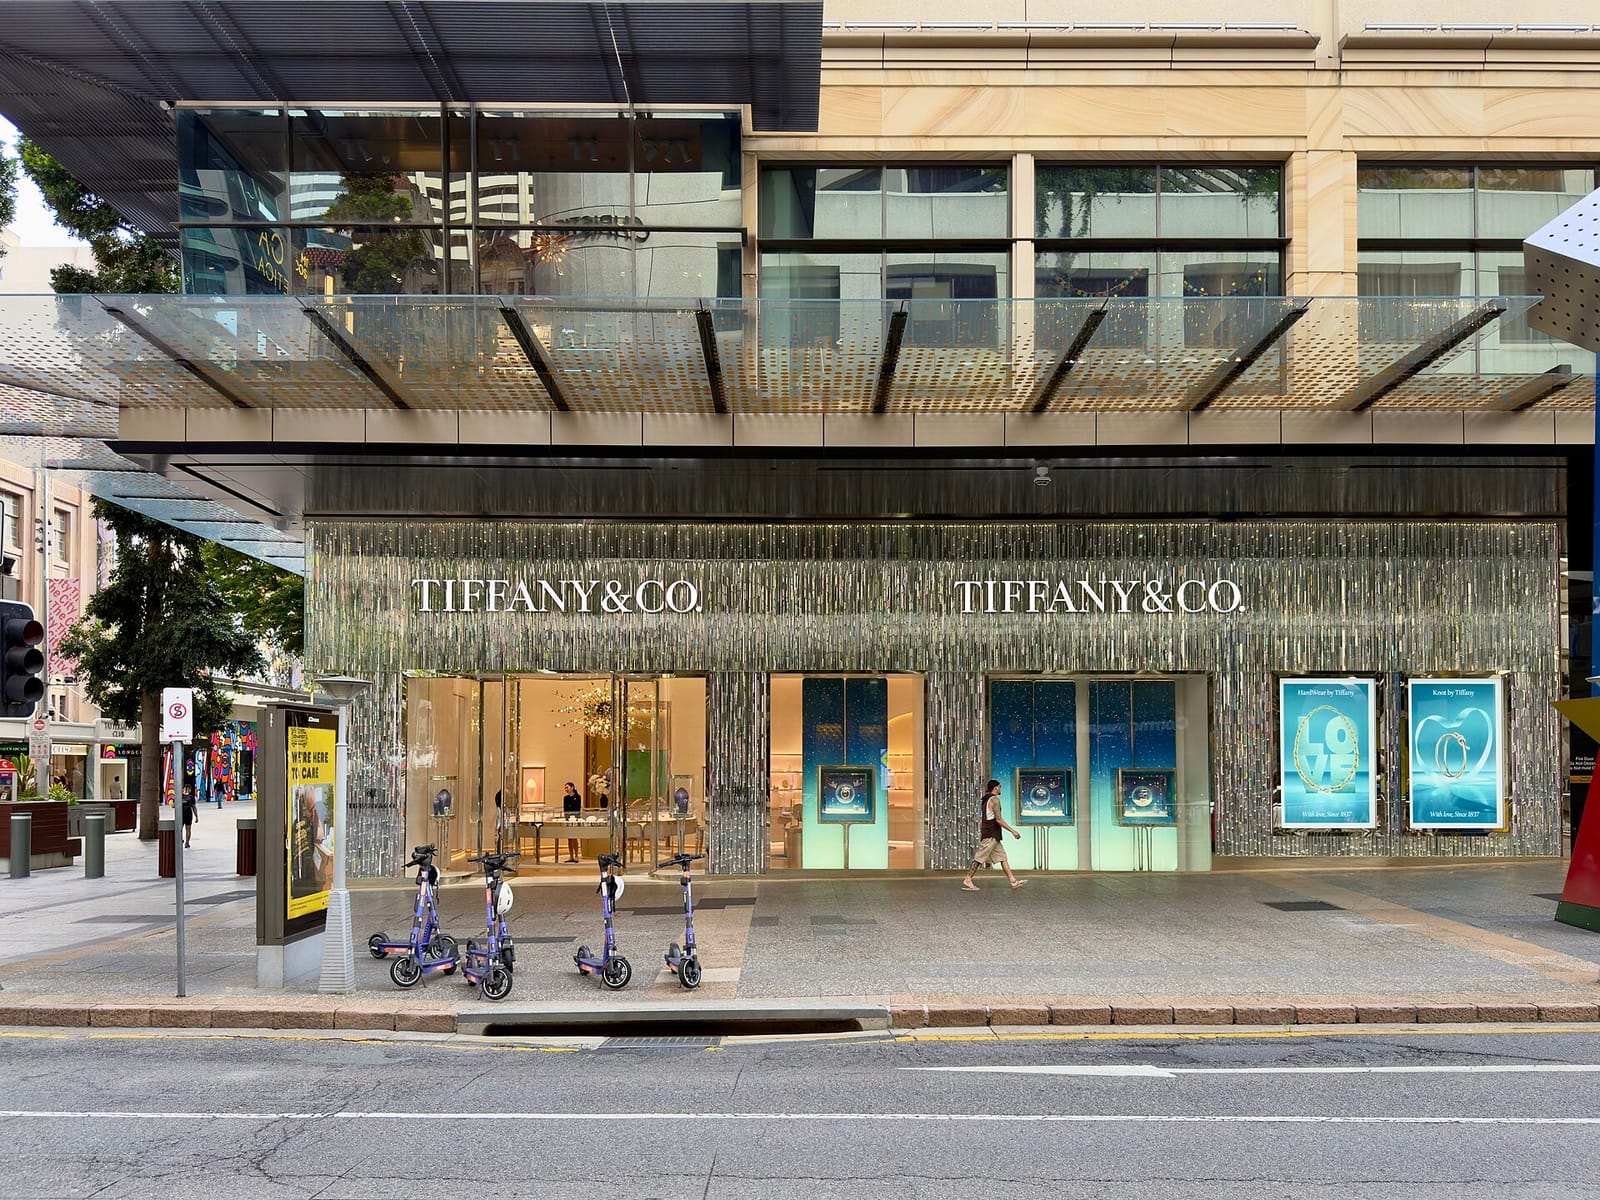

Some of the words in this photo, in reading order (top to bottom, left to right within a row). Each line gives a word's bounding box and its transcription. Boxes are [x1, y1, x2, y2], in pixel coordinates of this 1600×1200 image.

[411, 579, 703, 613] TIFFANY&CO.
[953, 579, 1246, 613] TIFFANY&CO.
[1327, 688, 1334, 698] by
[1335, 688, 1354, 698] Tiffany
[1447, 688, 1454, 698] by
[1455, 688, 1474, 698] Tiffany
[313, 751, 329, 764] HERE
[301, 767, 319, 780] CARE
